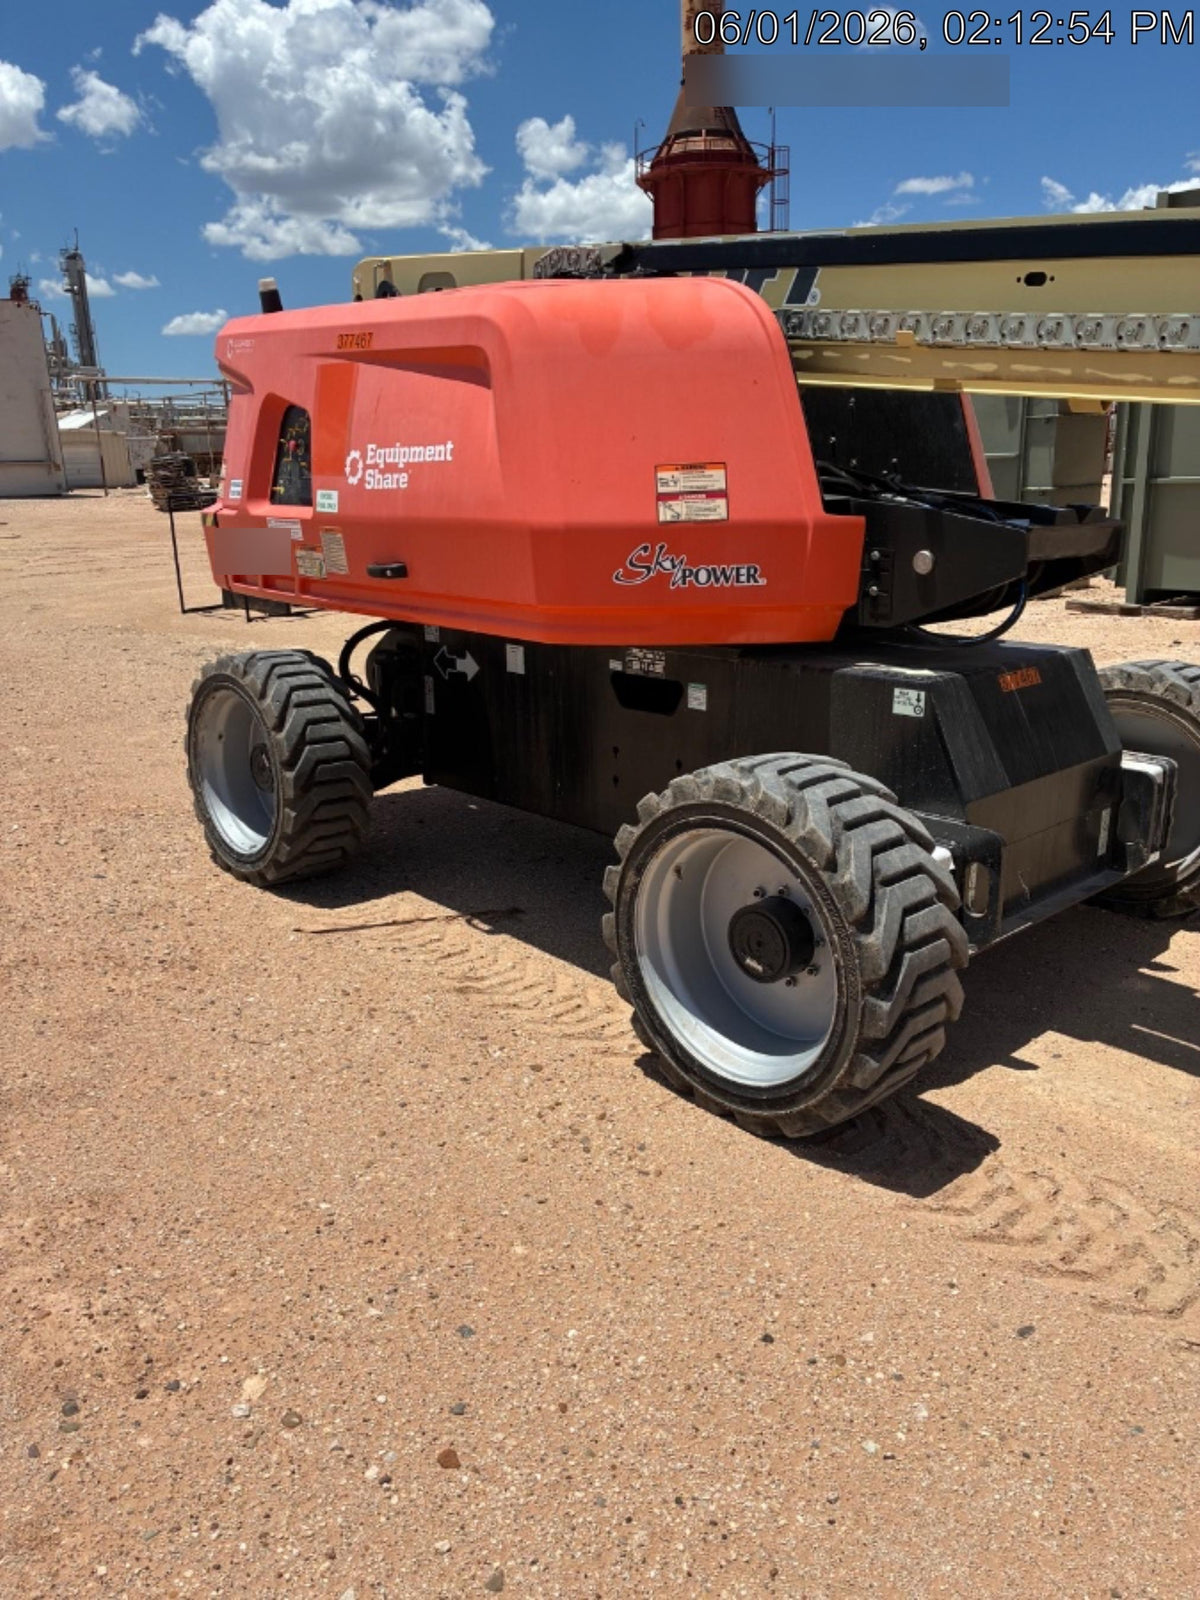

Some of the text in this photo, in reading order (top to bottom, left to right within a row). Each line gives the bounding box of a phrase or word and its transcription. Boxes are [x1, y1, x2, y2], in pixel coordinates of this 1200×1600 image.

[337, 332, 374, 350] 377467
[365, 440, 454, 468] Equipment
[364, 468, 409, 490] Share
